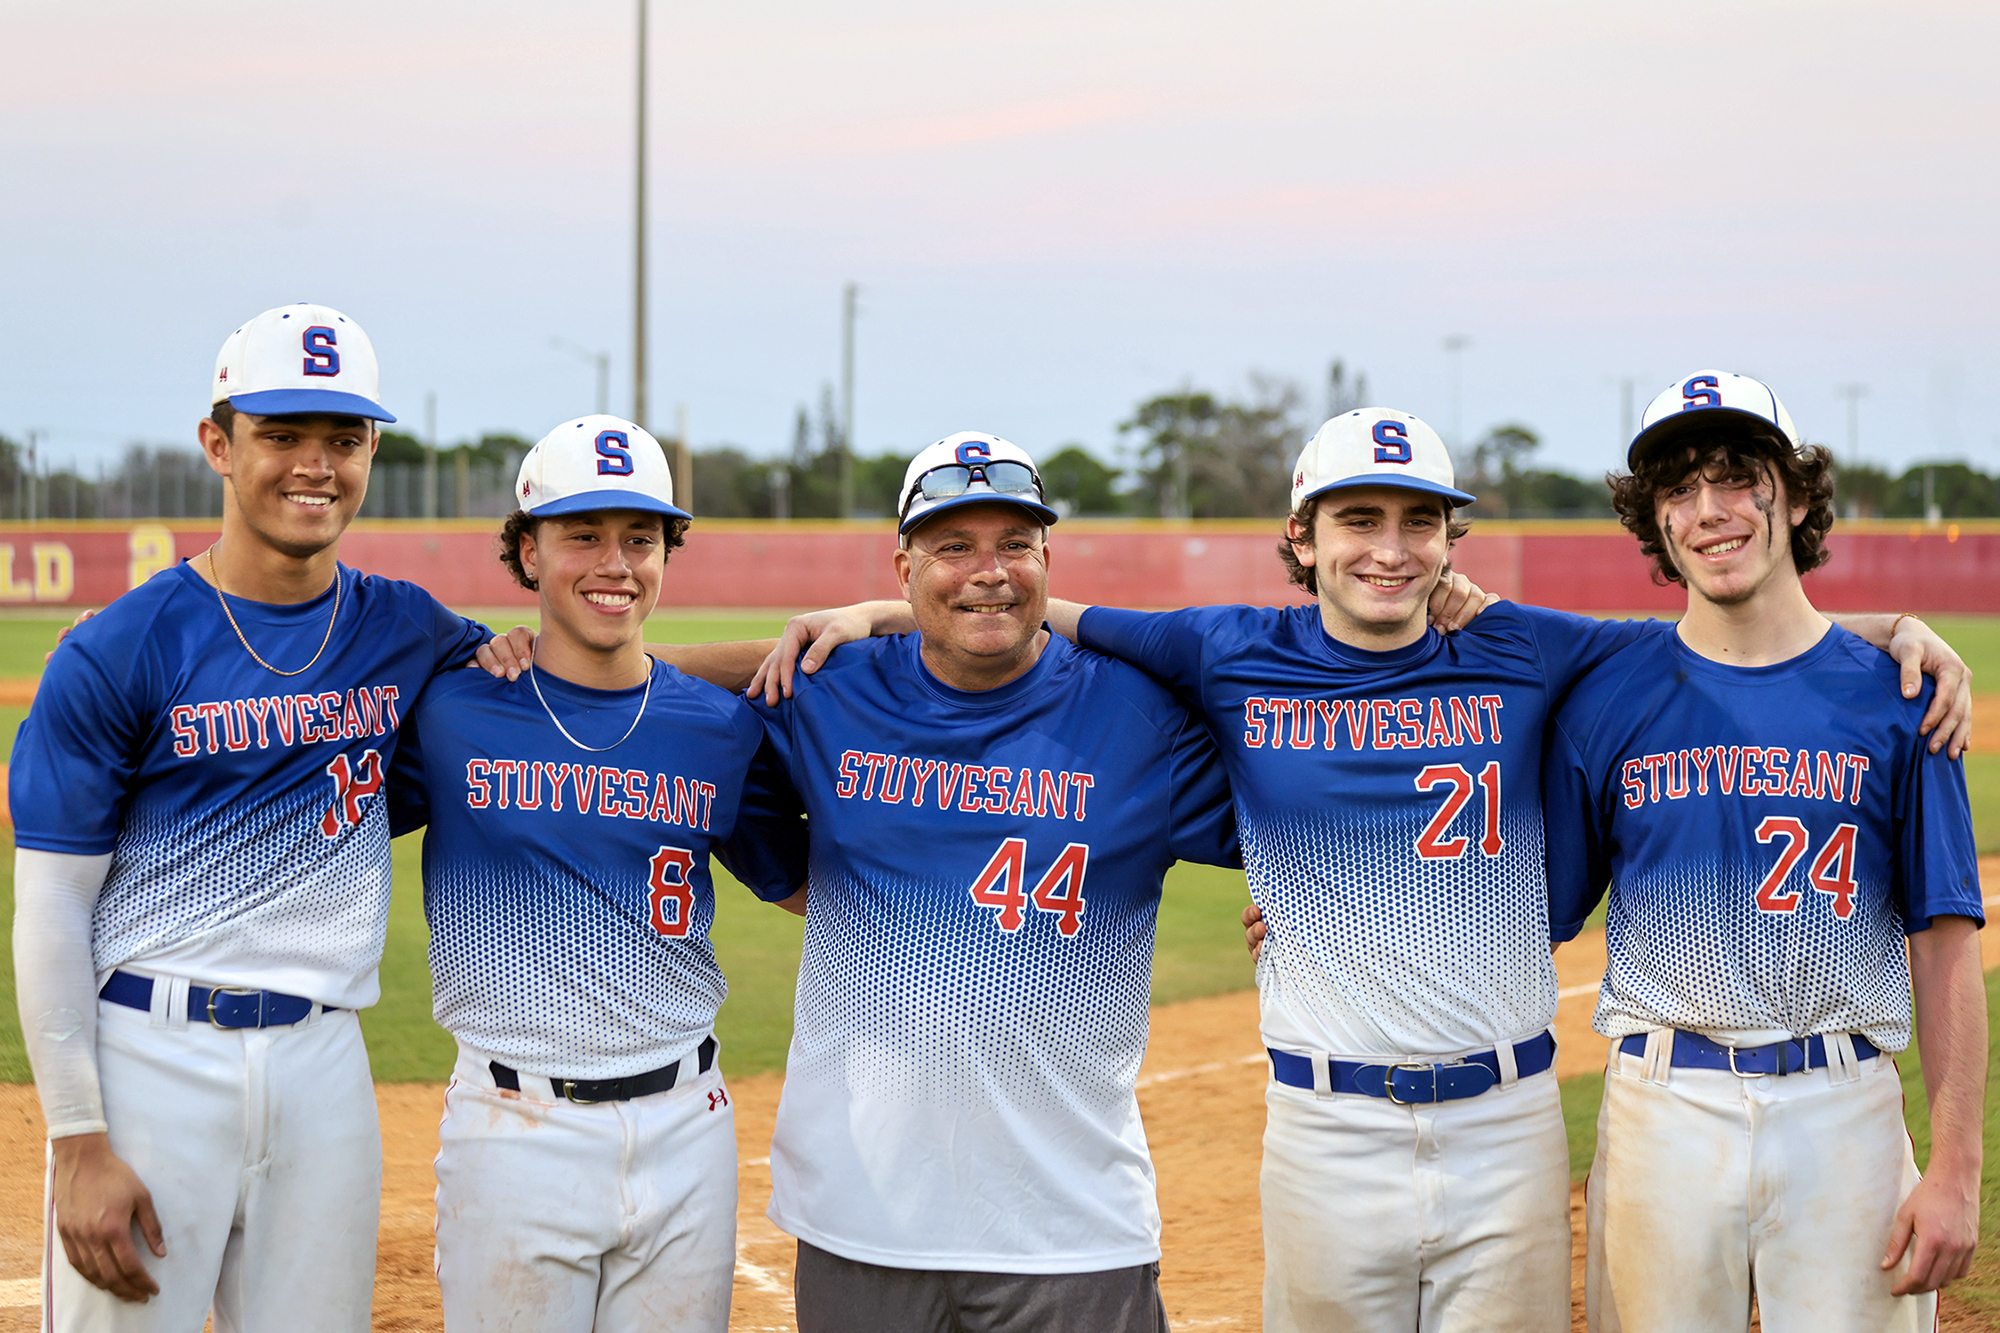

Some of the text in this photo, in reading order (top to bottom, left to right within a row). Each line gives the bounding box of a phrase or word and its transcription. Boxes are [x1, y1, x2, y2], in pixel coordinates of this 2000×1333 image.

[302, 325, 340, 378] S
[1682, 375, 1722, 411] S
[595, 430, 634, 477] S
[1371, 419, 1413, 465] S
[170, 685, 400, 758] STUYVESANT
[1244, 694, 1504, 751] STUYVESANT
[466, 758, 716, 831] STUYVESANT
[836, 749, 1095, 822] STUYVESANT
[1414, 760, 1505, 861] 21
[1621, 745, 1869, 810] STUYVESANT
[648, 845, 696, 939] 8
[969, 837, 1090, 938] 44
[1754, 815, 1859, 920] 24
